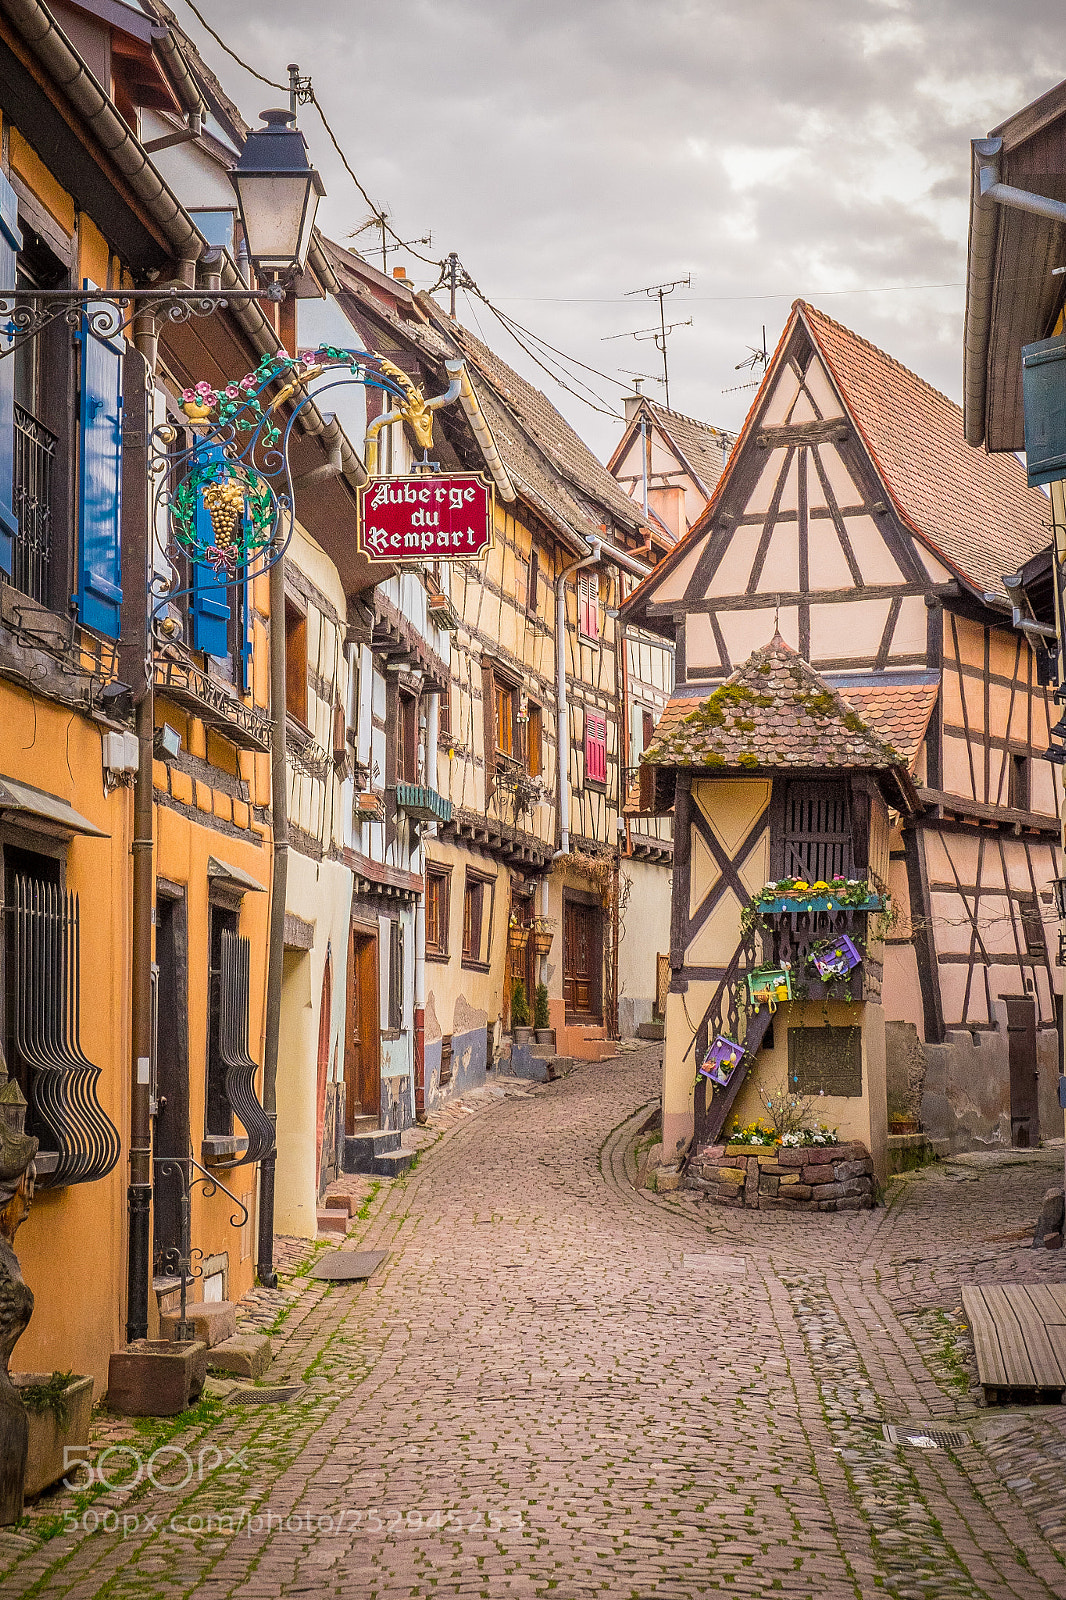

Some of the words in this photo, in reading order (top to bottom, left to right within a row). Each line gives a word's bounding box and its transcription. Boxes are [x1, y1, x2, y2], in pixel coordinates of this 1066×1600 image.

[370, 483, 476, 511] Auberge
[411, 507, 440, 527] du
[368, 526, 476, 553] Rempart
